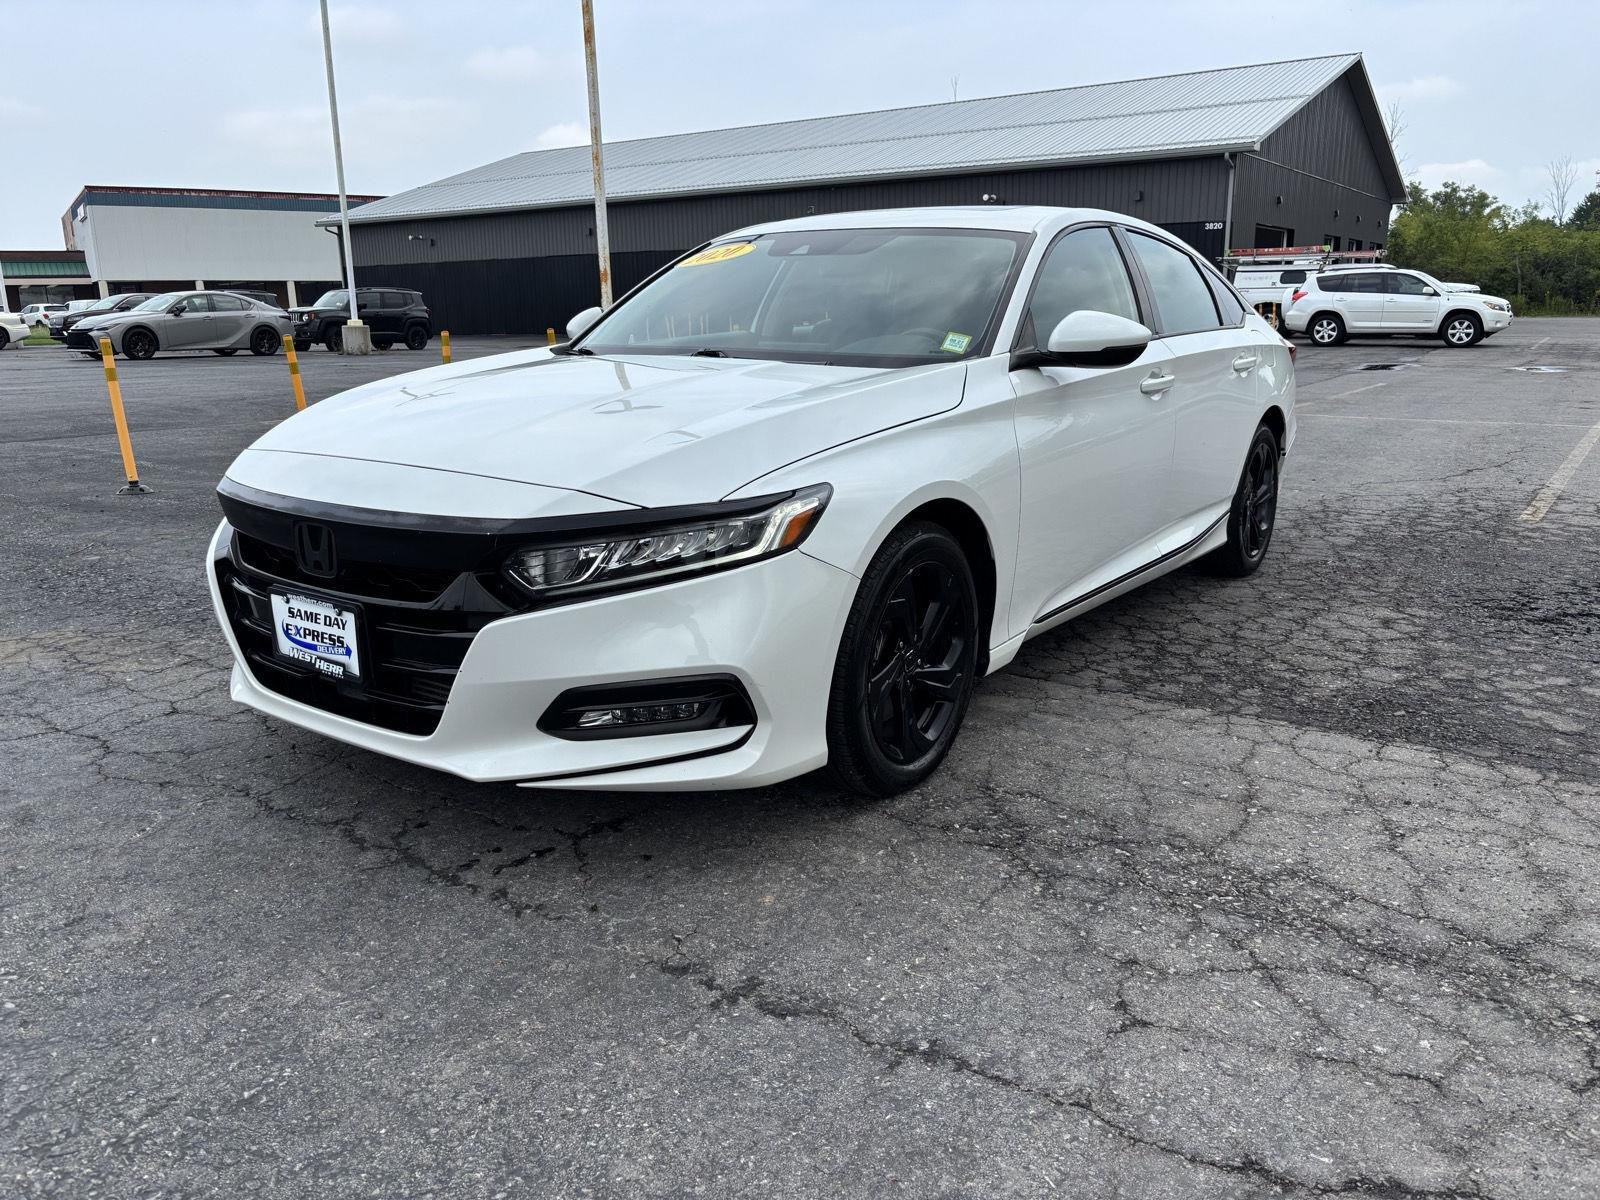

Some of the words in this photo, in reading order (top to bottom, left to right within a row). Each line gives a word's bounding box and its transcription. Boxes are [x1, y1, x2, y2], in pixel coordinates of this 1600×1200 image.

[1204, 222, 1223, 230] 3820
[287, 606, 321, 624] SAME
[323, 614, 347, 631] DAY
[285, 623, 345, 648] EXPRESS
[316, 645, 346, 655] DELIVERY
